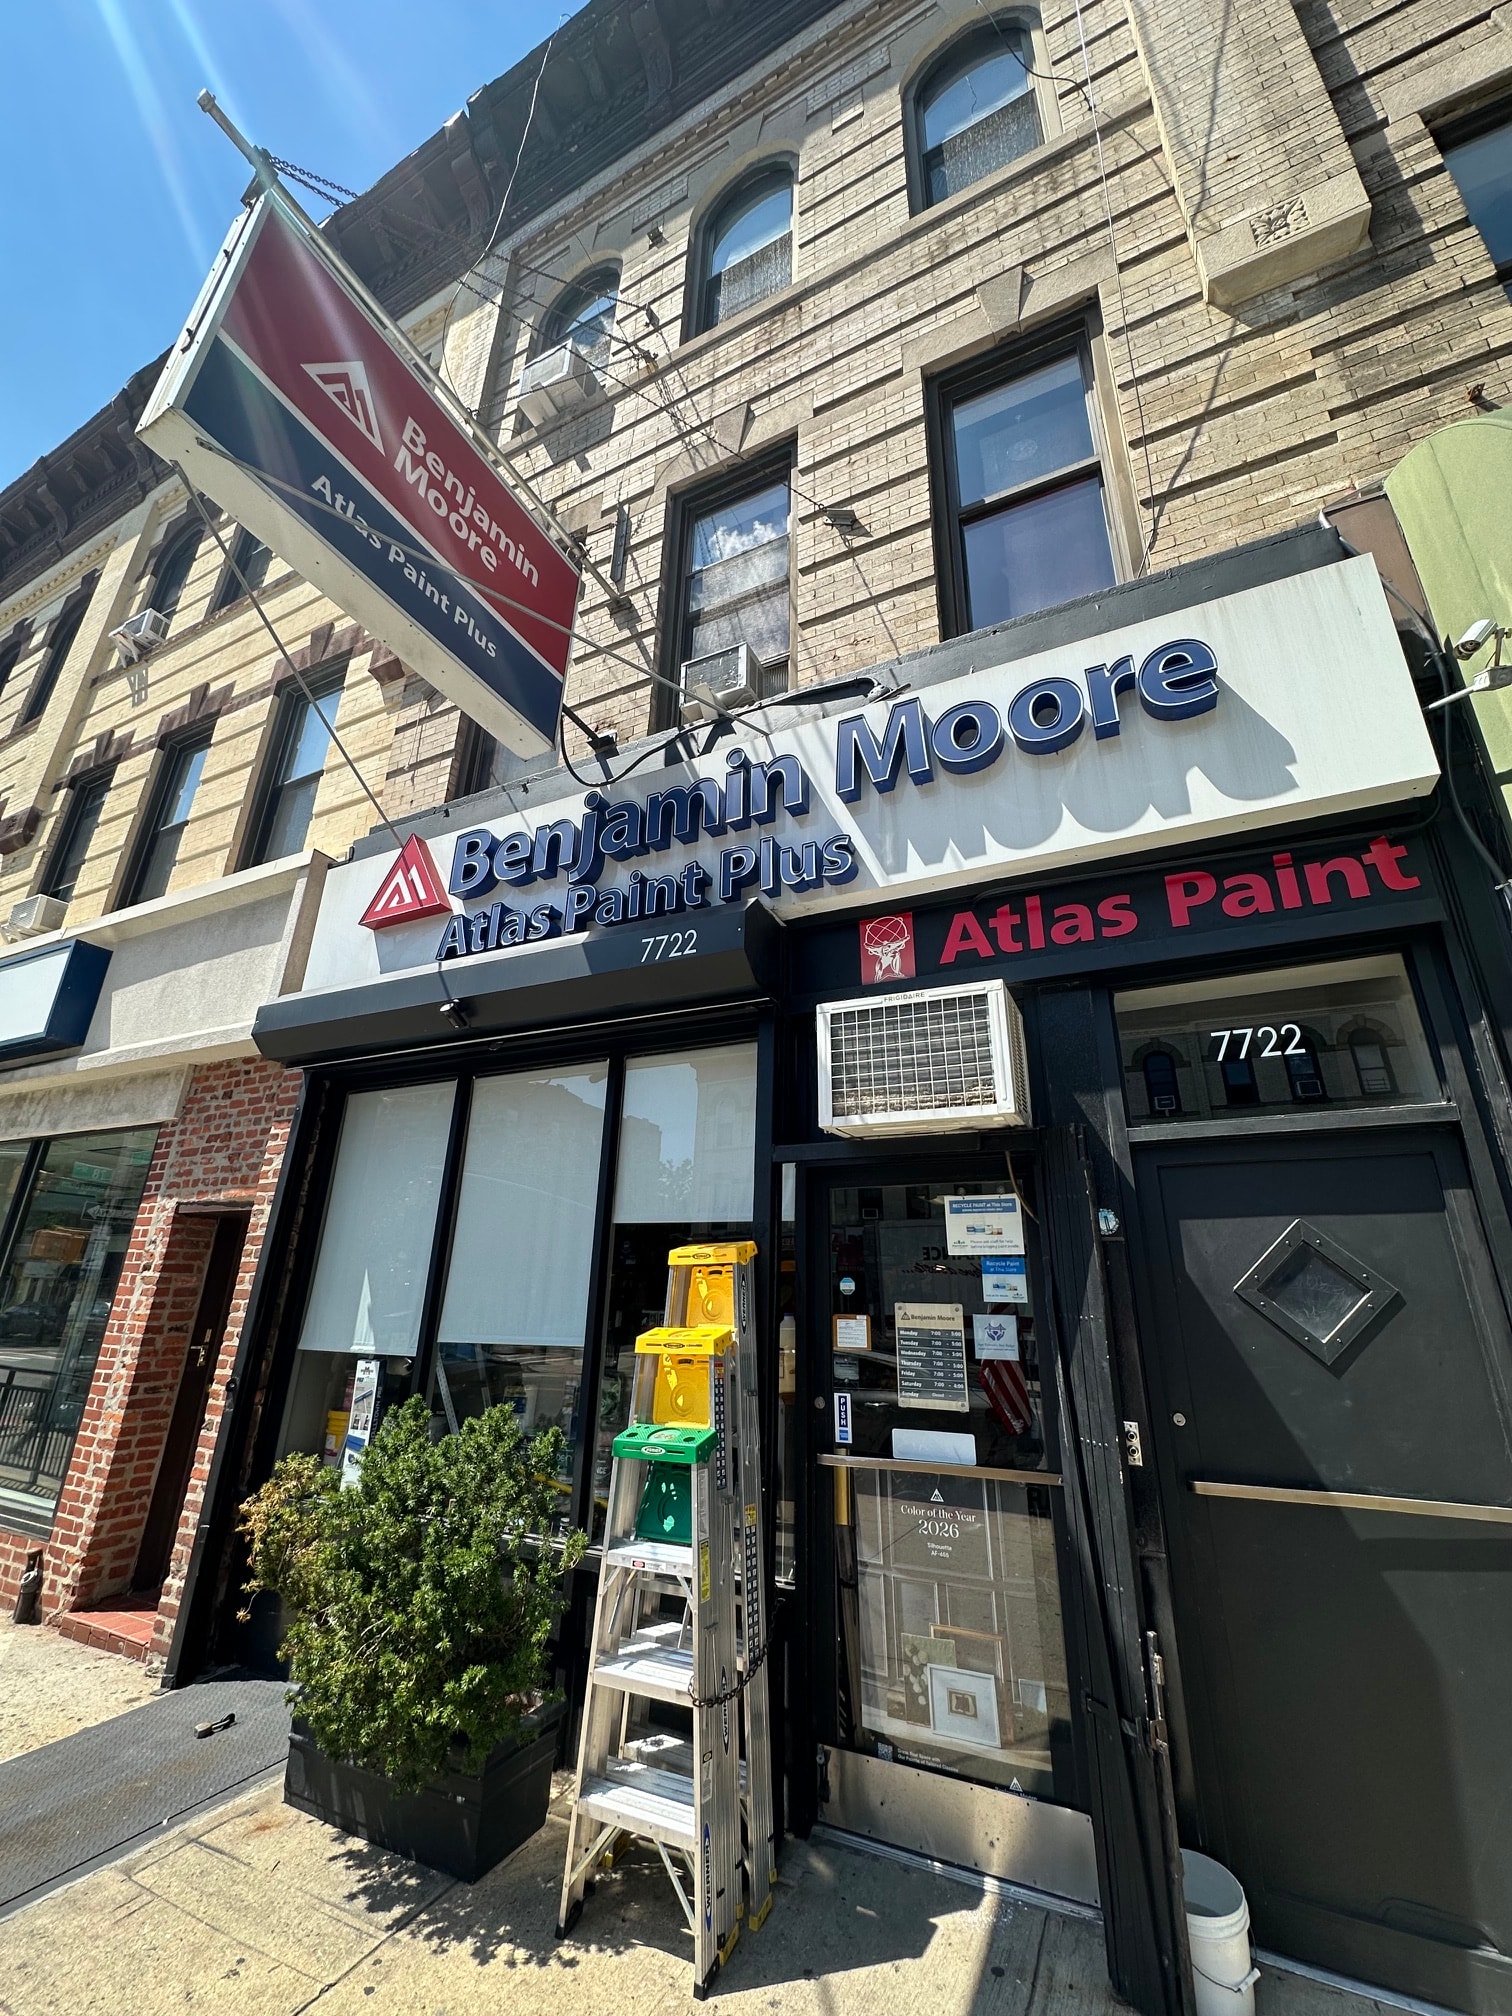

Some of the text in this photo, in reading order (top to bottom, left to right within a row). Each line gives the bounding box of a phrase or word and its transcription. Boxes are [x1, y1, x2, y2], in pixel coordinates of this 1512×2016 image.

[393, 445, 500, 573] Moore
[400, 416, 540, 588] Benjamin
[311, 474, 497, 659] Atlas Paint Plus
[448, 637, 1219, 900] Benjamin Moore
[436, 834, 858, 961] Atlas Paint Plus
[939, 835, 1421, 964] Atlas Paint
[640, 930, 698, 963] 7722
[883, 991, 926, 1003] FRIGIDAIRE
[1210, 1025, 1306, 1062] 7722
[911, 1313, 936, 1321] Benjamin
[900, 1504, 977, 1523] Color of the Year
[918, 1519, 959, 1539] 2026
